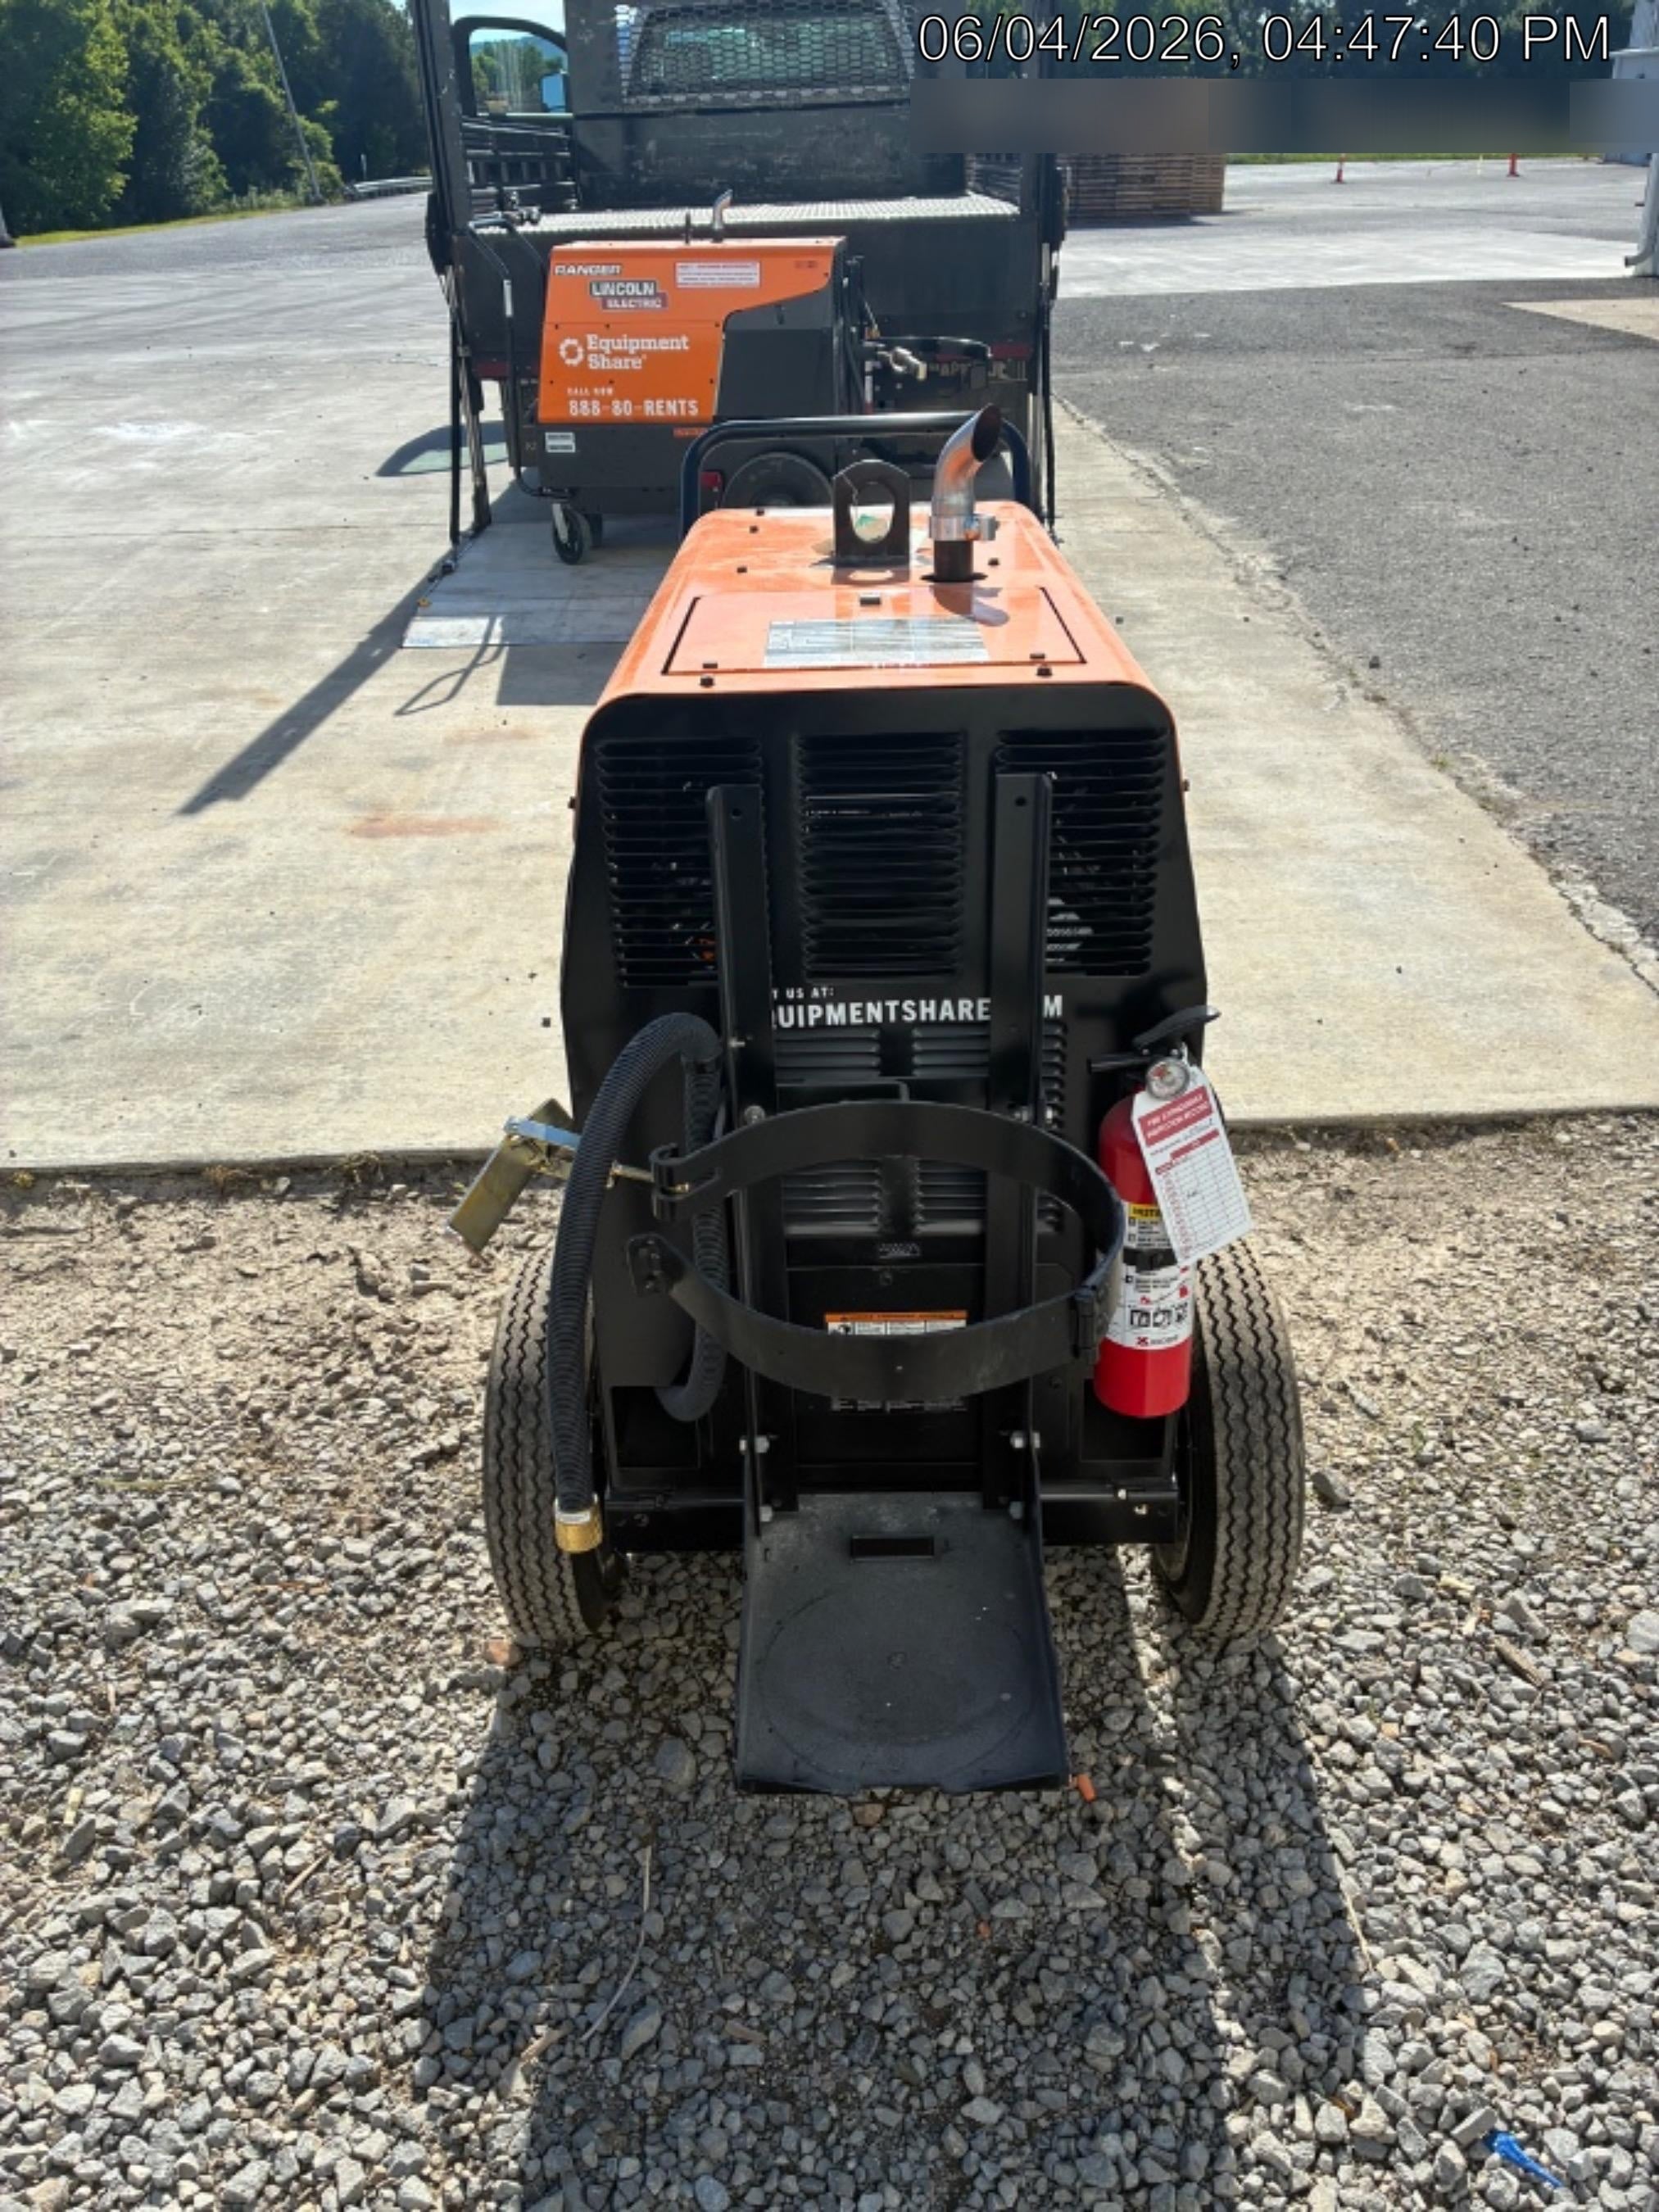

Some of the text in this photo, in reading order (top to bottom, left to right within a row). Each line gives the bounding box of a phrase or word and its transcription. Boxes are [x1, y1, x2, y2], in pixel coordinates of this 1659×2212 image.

[555, 264, 621, 275] RANGER
[592, 282, 655, 296] LINCOLN
[607, 299, 662, 309] ELECTRIC
[587, 333, 690, 354] Equipment
[587, 353, 642, 369] Share
[569, 399, 699, 416] 888-80-RENTS
[786, 986, 805, 999] US
[810, 986, 835, 999] AT:
